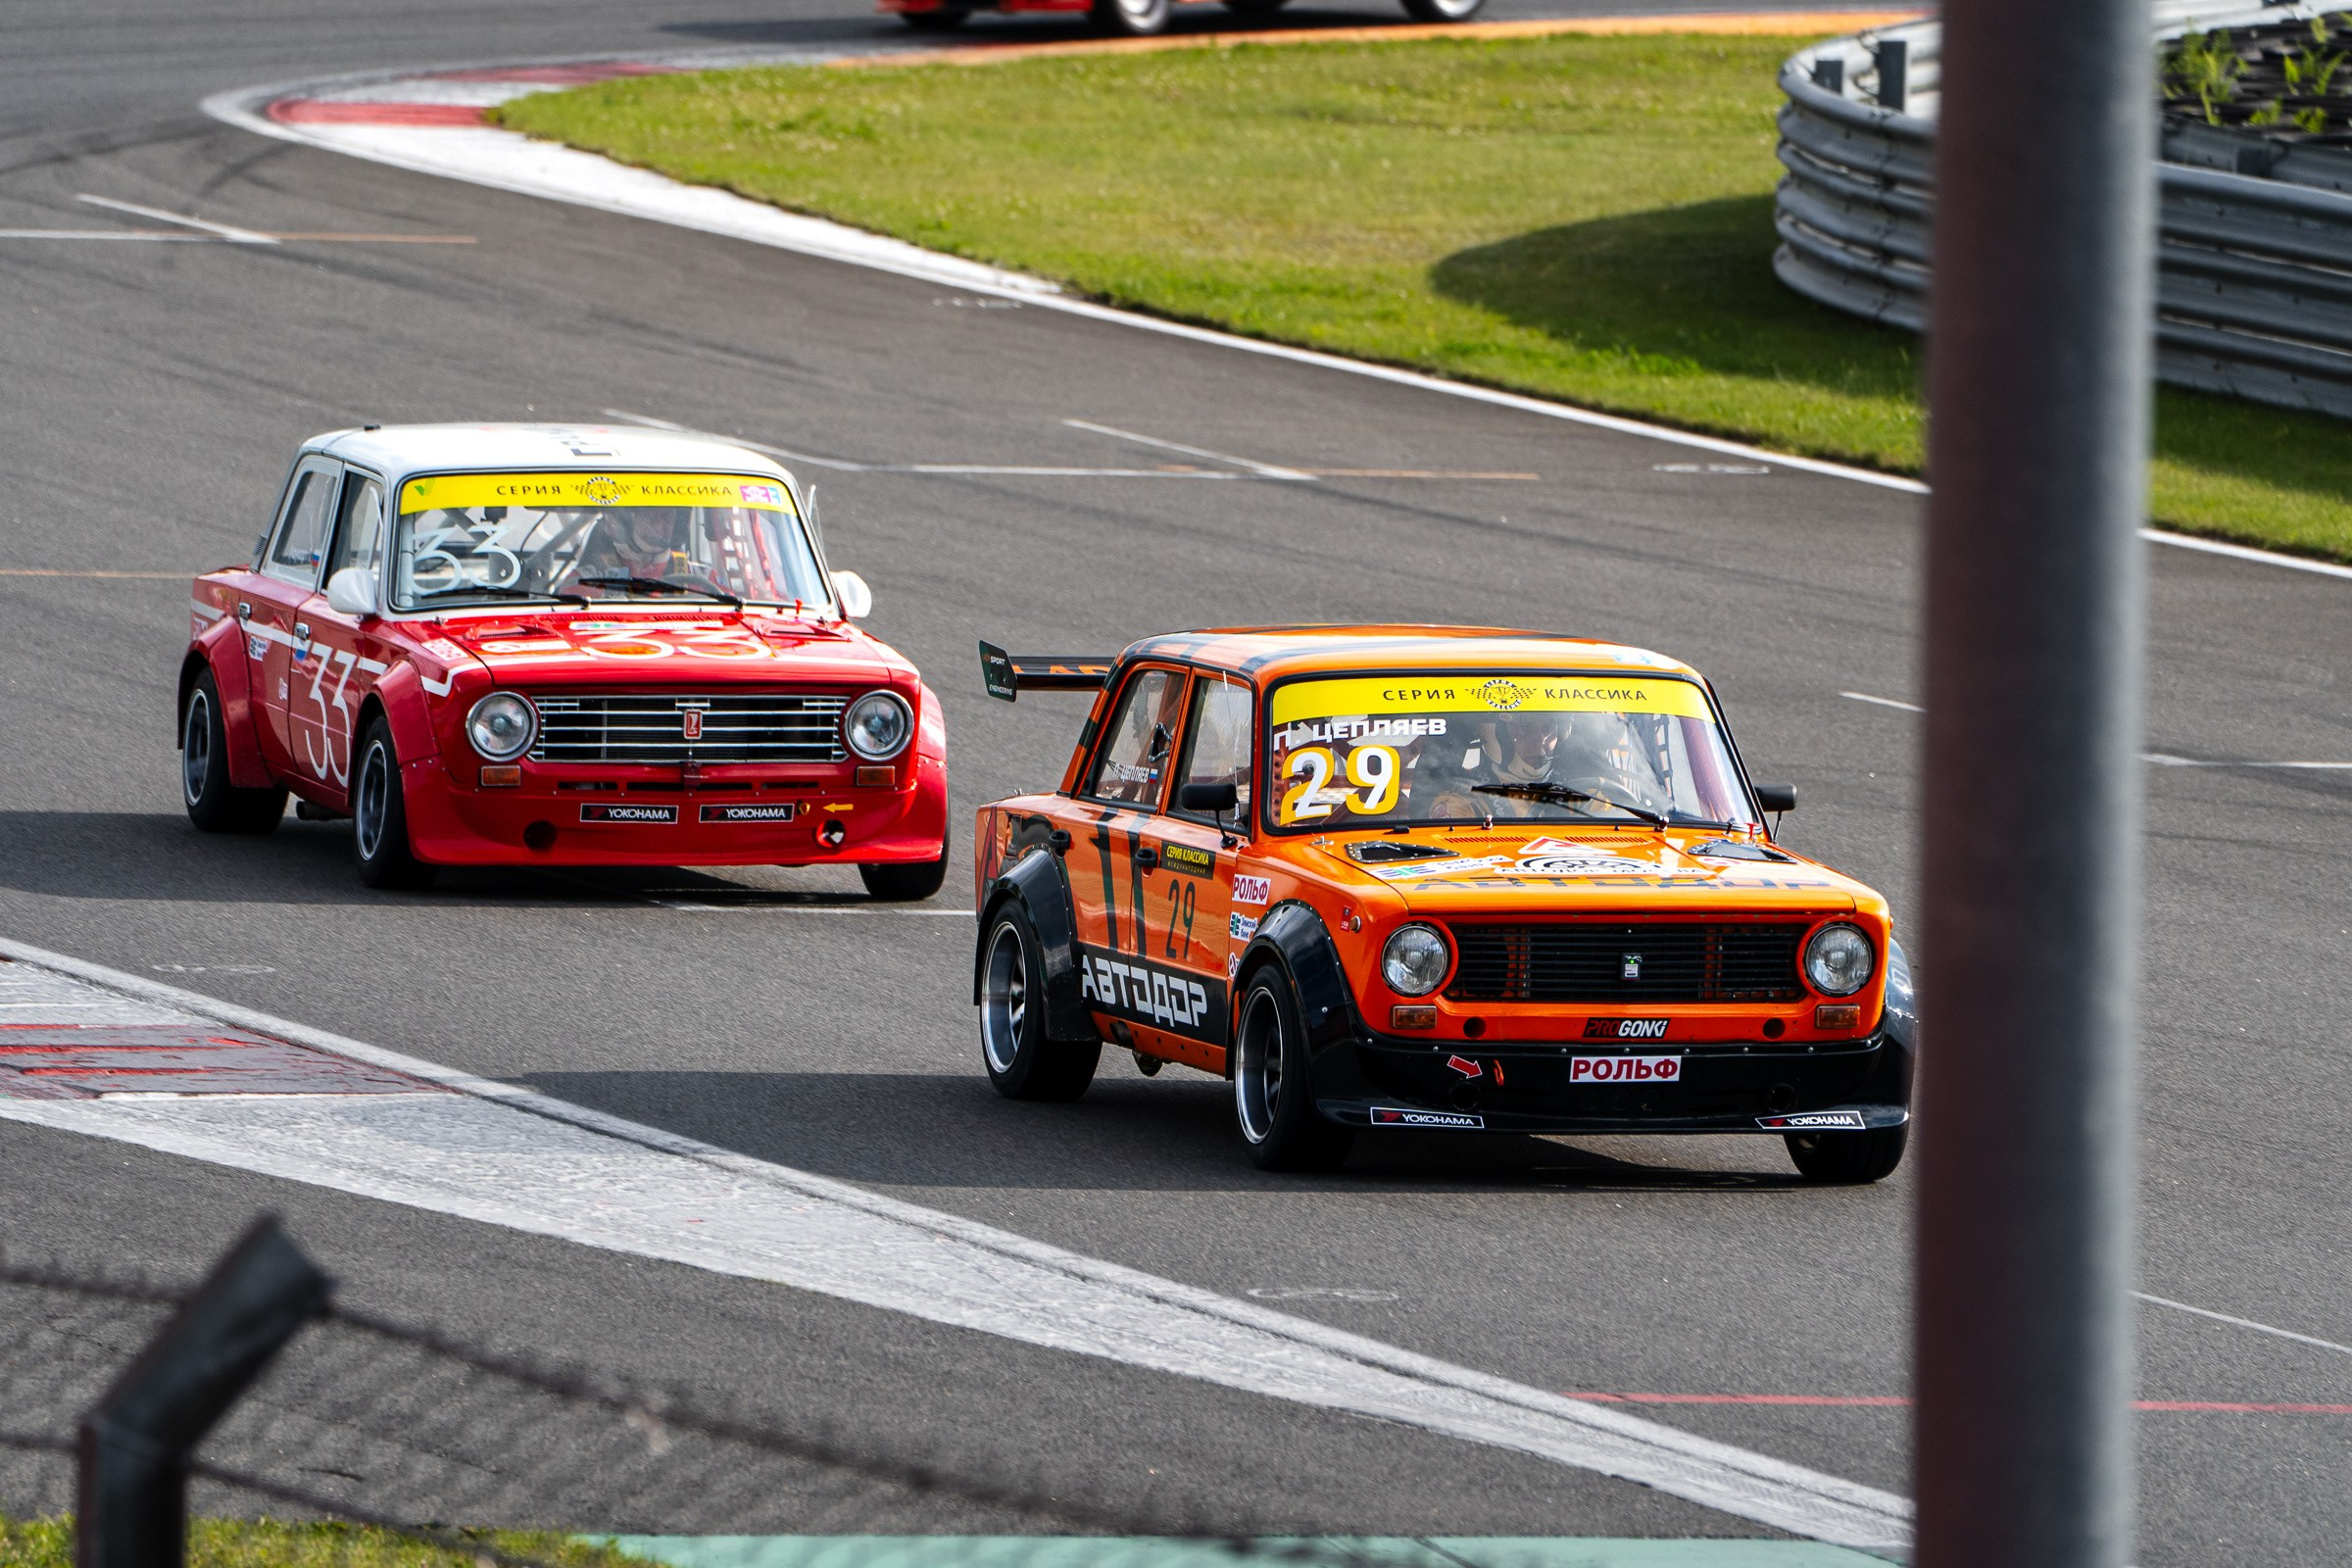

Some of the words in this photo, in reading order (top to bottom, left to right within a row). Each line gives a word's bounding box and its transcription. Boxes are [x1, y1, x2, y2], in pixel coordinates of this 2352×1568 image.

[496, 485, 562, 496] СЕРИЯ
[641, 485, 733, 496] КЛАССИКА
[413, 524, 522, 598] 33
[573, 629, 773, 661] 33
[990, 655, 1005, 665] SPORT
[1382, 688, 1456, 702] СЕРИЯ
[1544, 688, 1648, 702] КЛАССИКА
[305, 642, 357, 788] 33
[1273, 729, 1301, 752] П.
[1312, 718, 1447, 744] ЦЕПЛЯЕВ
[1279, 744, 1401, 826] 29
[608, 807, 670, 819] YOKOHAMA
[725, 808, 786, 818] YOKOHAMA
[1166, 845, 1182, 860] СЕРИЯ
[1182, 848, 1209, 866] КЛАССИКА
[1232, 876, 1269, 902] РОЛЬФ
[1165, 879, 1196, 960] 29
[1081, 954, 1208, 1028] АВТОДОР
[1572, 1058, 1679, 1081] РОЛЬФ
[1401, 1113, 1475, 1126] YOKOHAMA
[1787, 1115, 1856, 1126] YOKOHAMA
